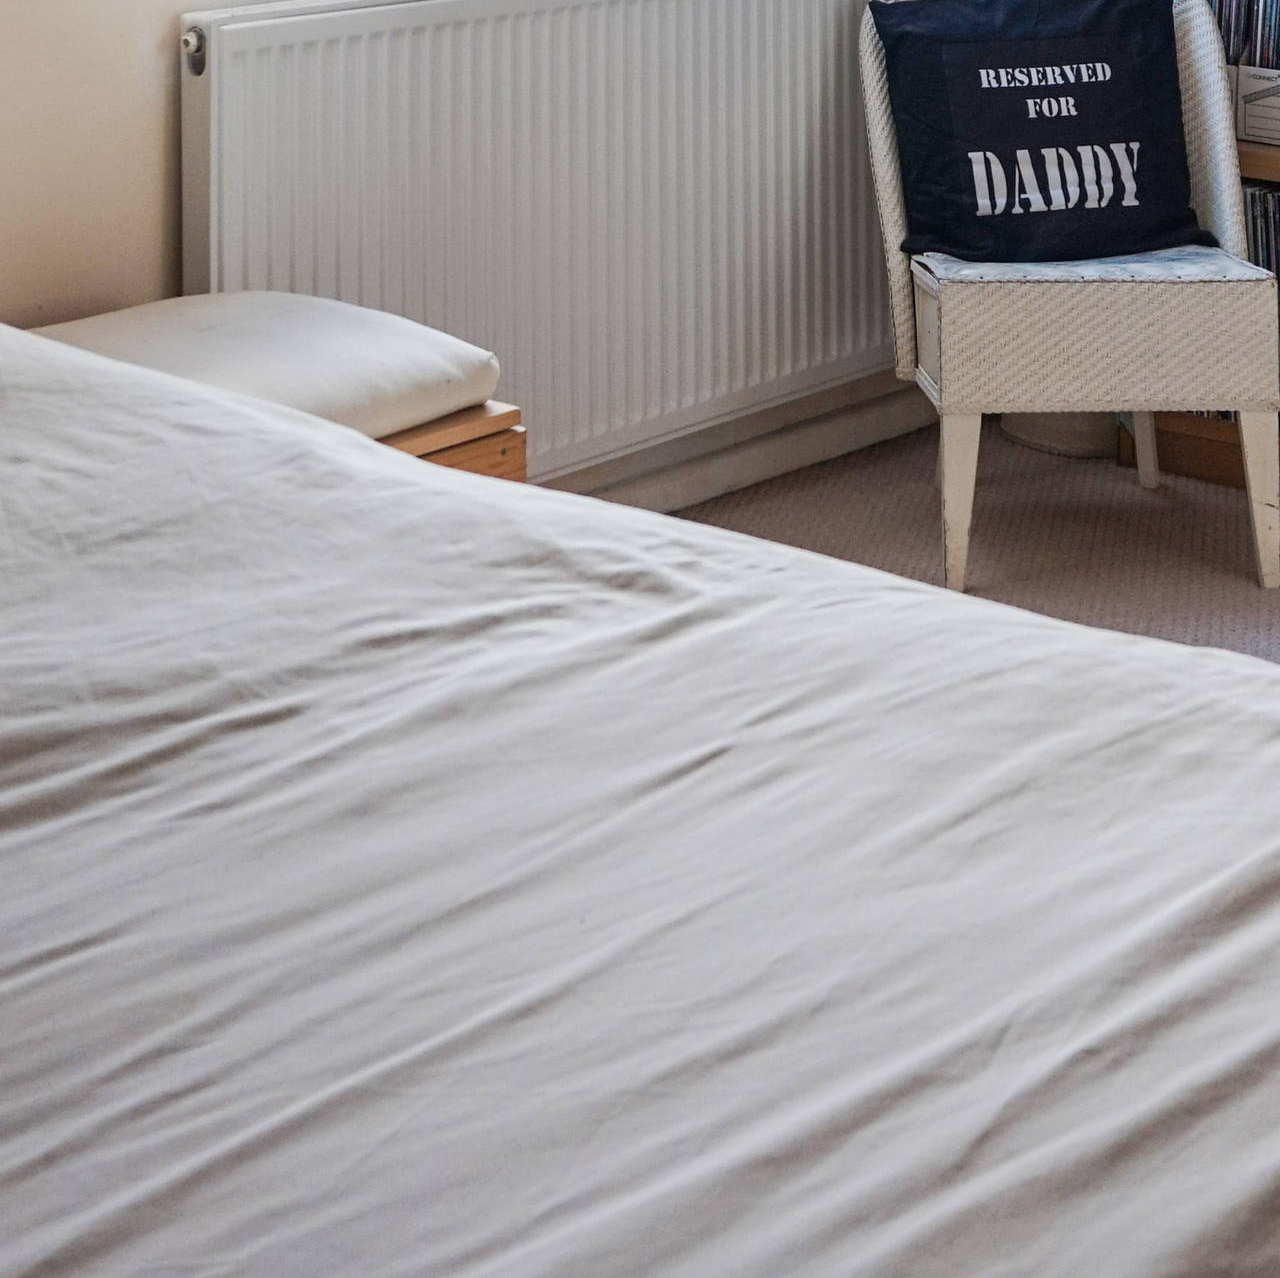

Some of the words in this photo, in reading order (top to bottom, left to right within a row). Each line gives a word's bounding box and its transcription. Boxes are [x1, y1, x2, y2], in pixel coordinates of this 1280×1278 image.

[979, 62, 1111, 88] RESERVED
[1026, 97, 1078, 118] FOR
[968, 142, 1140, 216] DADDY
